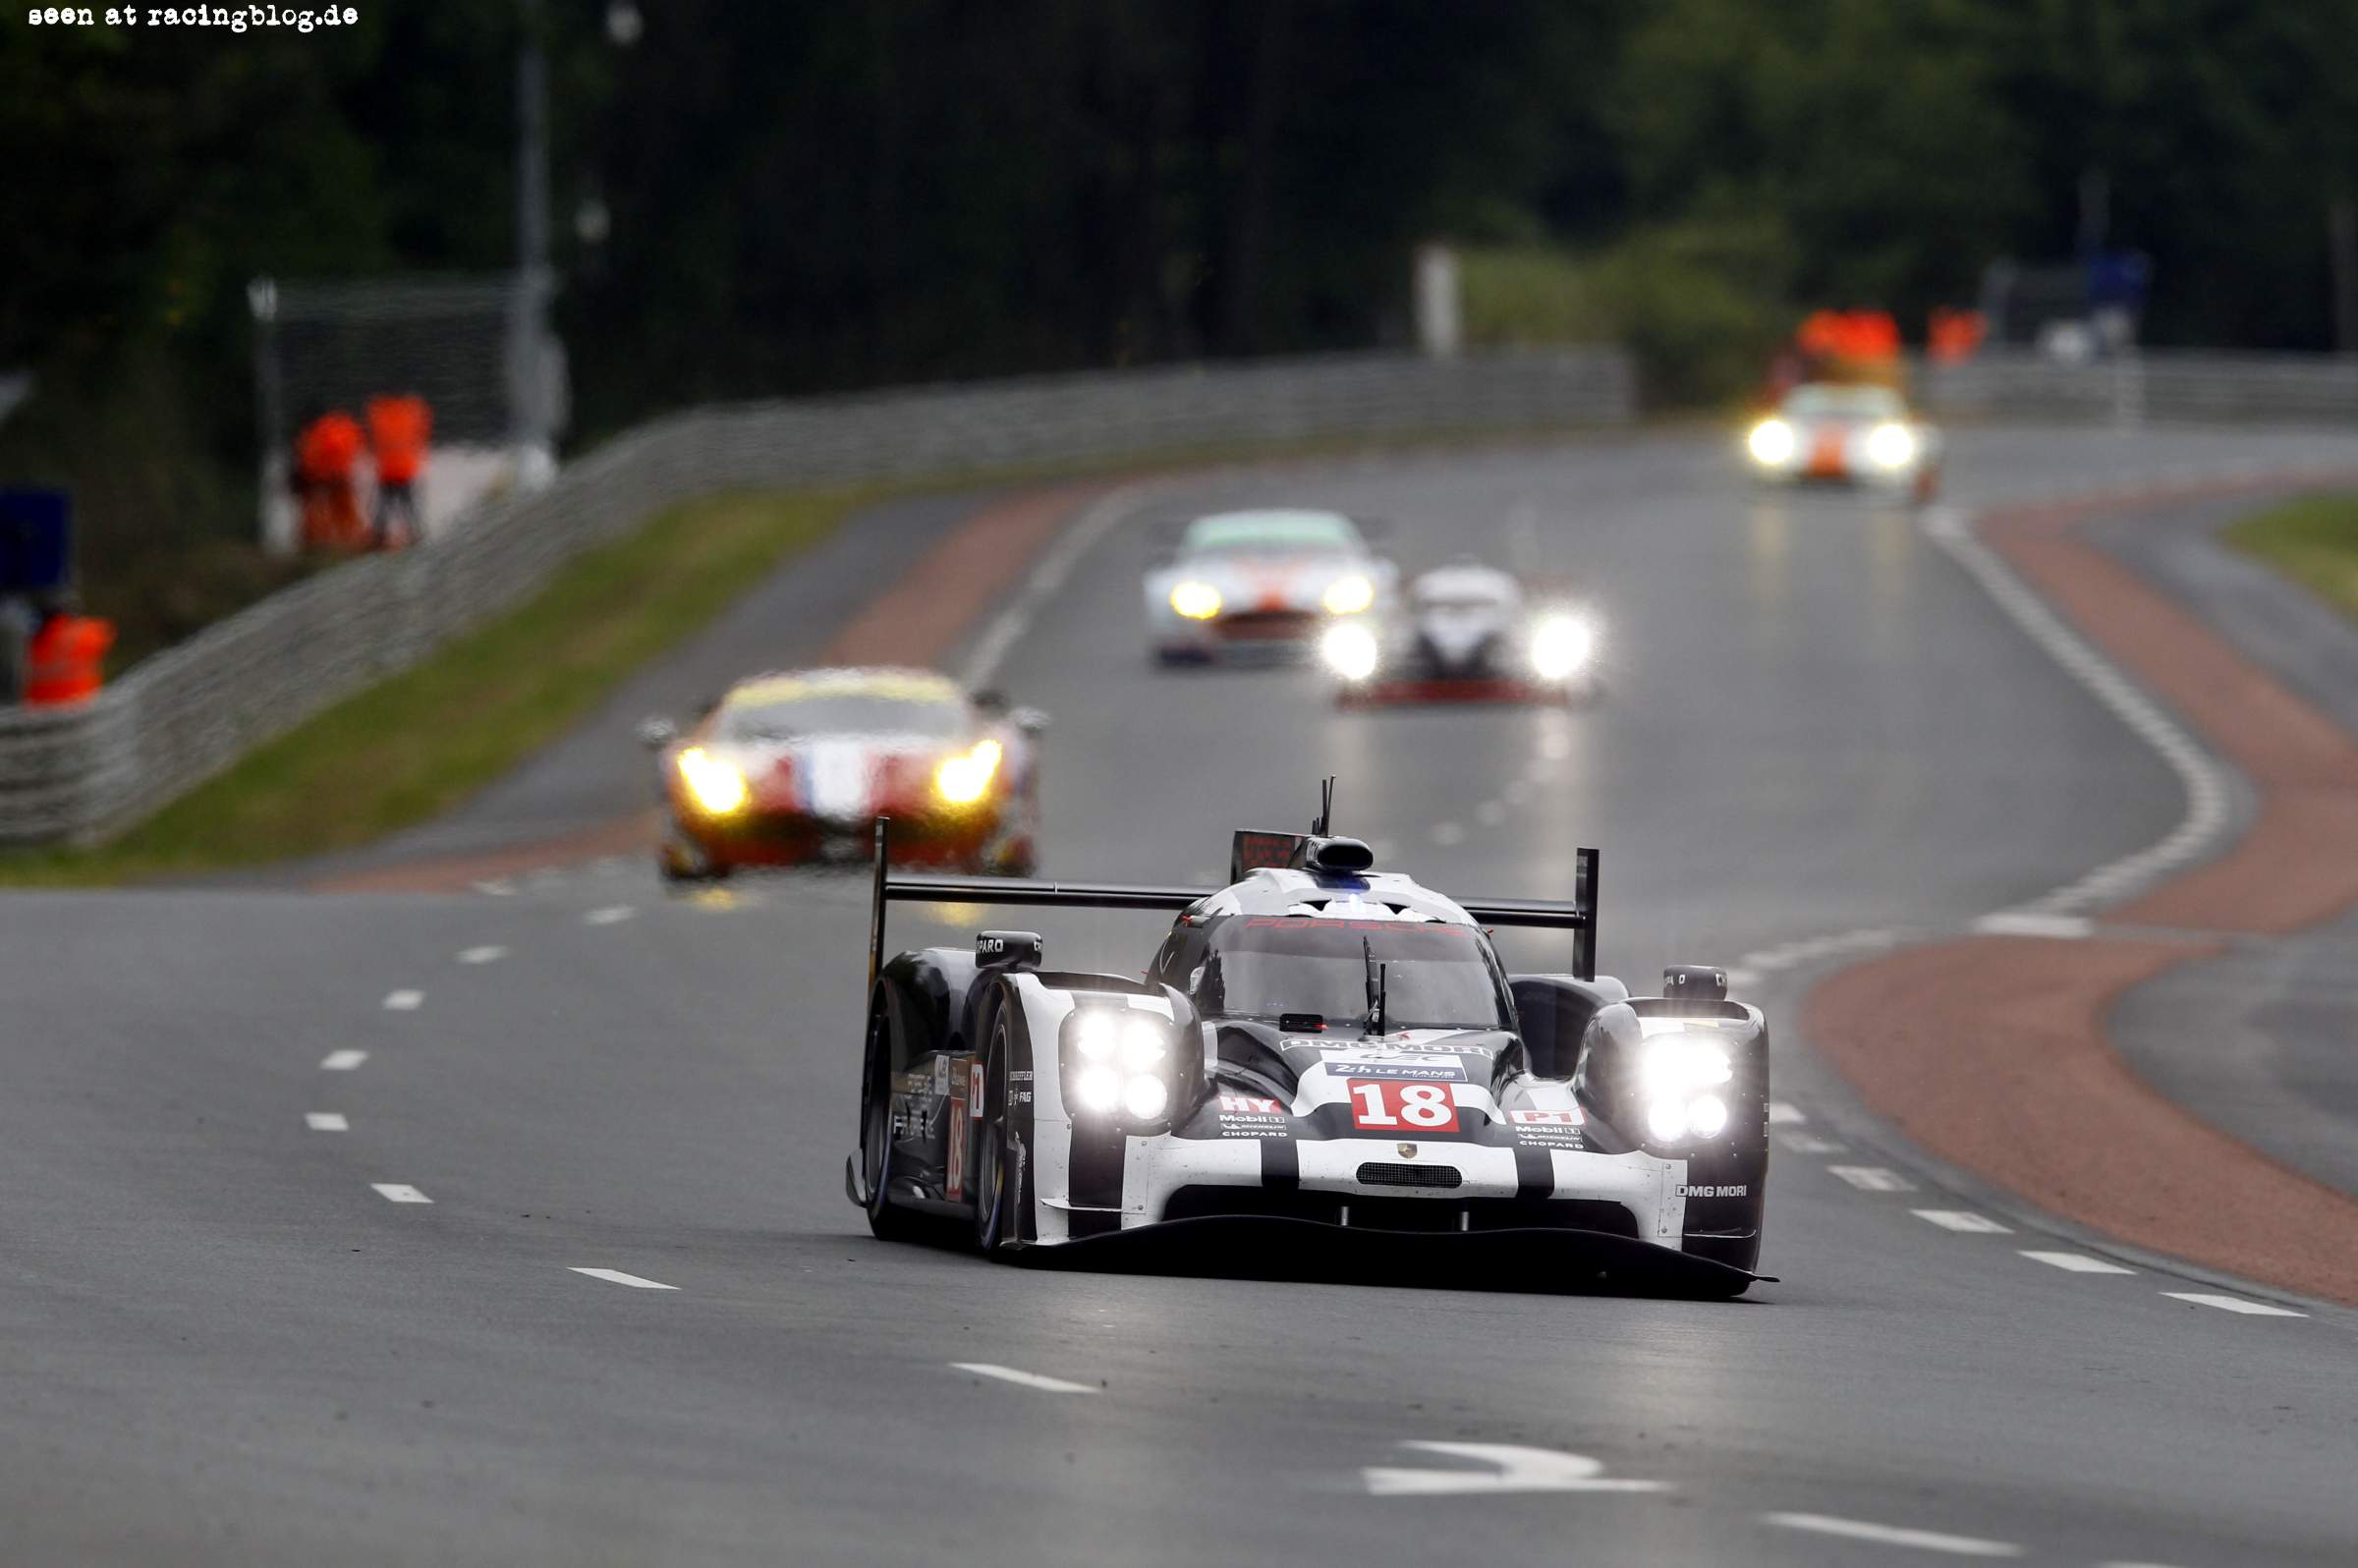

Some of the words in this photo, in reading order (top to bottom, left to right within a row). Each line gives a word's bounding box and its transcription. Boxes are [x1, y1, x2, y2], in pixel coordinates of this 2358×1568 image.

[1219, 1095, 1274, 1113] HY
[1353, 1084, 1452, 1127] 18
[1219, 1114, 1267, 1123] Mobil
[1523, 1112, 1573, 1123] P1
[1519, 1141, 1584, 1149] CHOPARD
[1676, 1185, 1714, 1197] DMG
[1716, 1185, 1747, 1197] MORI
